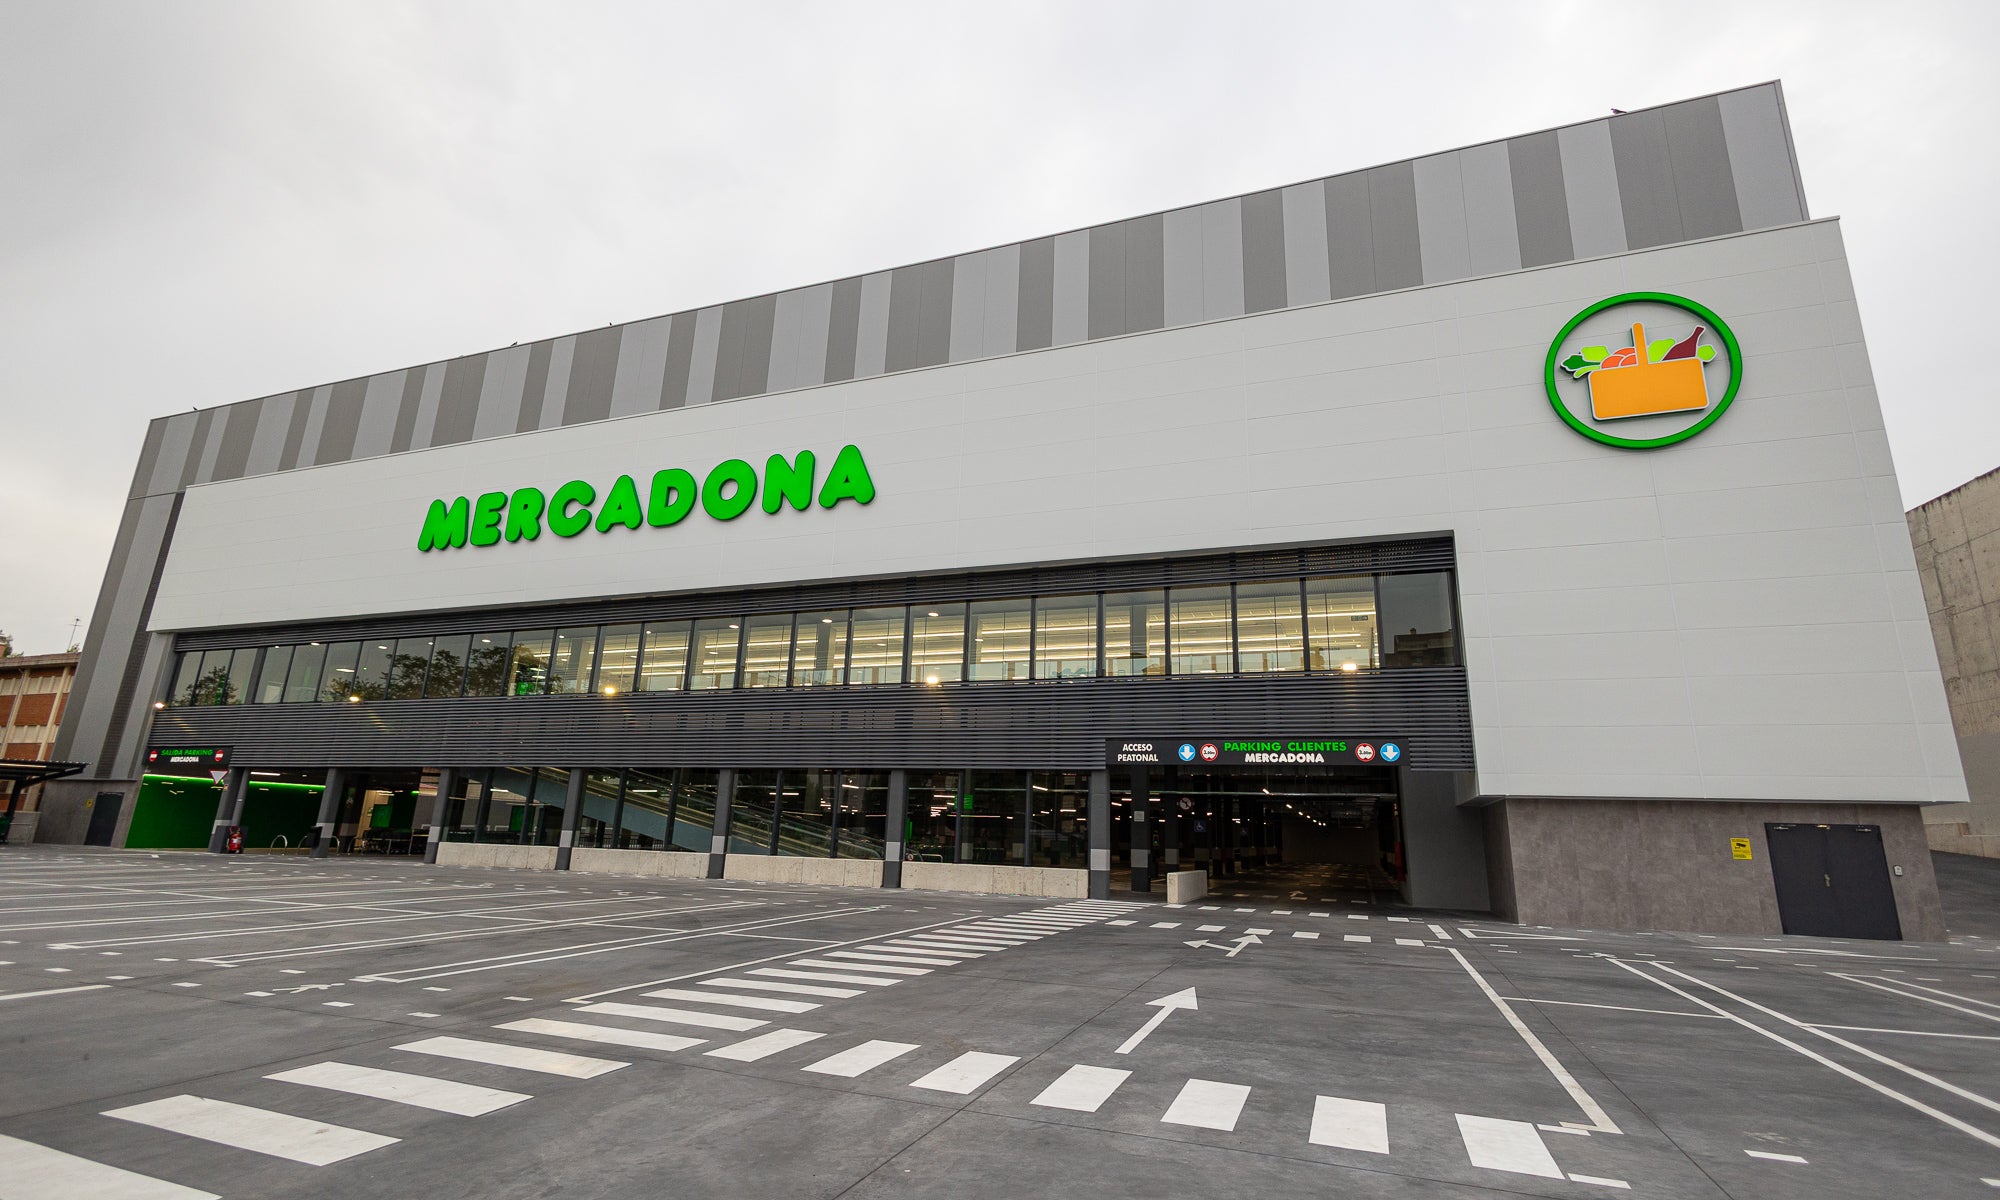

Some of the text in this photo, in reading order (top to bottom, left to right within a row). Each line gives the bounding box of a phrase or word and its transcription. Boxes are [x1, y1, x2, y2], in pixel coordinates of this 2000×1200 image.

[417, 444, 876, 552] MERCADONA
[1122, 743, 1153, 752] ACCESO
[1224, 741, 1347, 752] PARKING CLIENTES
[1117, 753, 1159, 762] PEATONAL
[1244, 752, 1325, 763] MERCADONA
